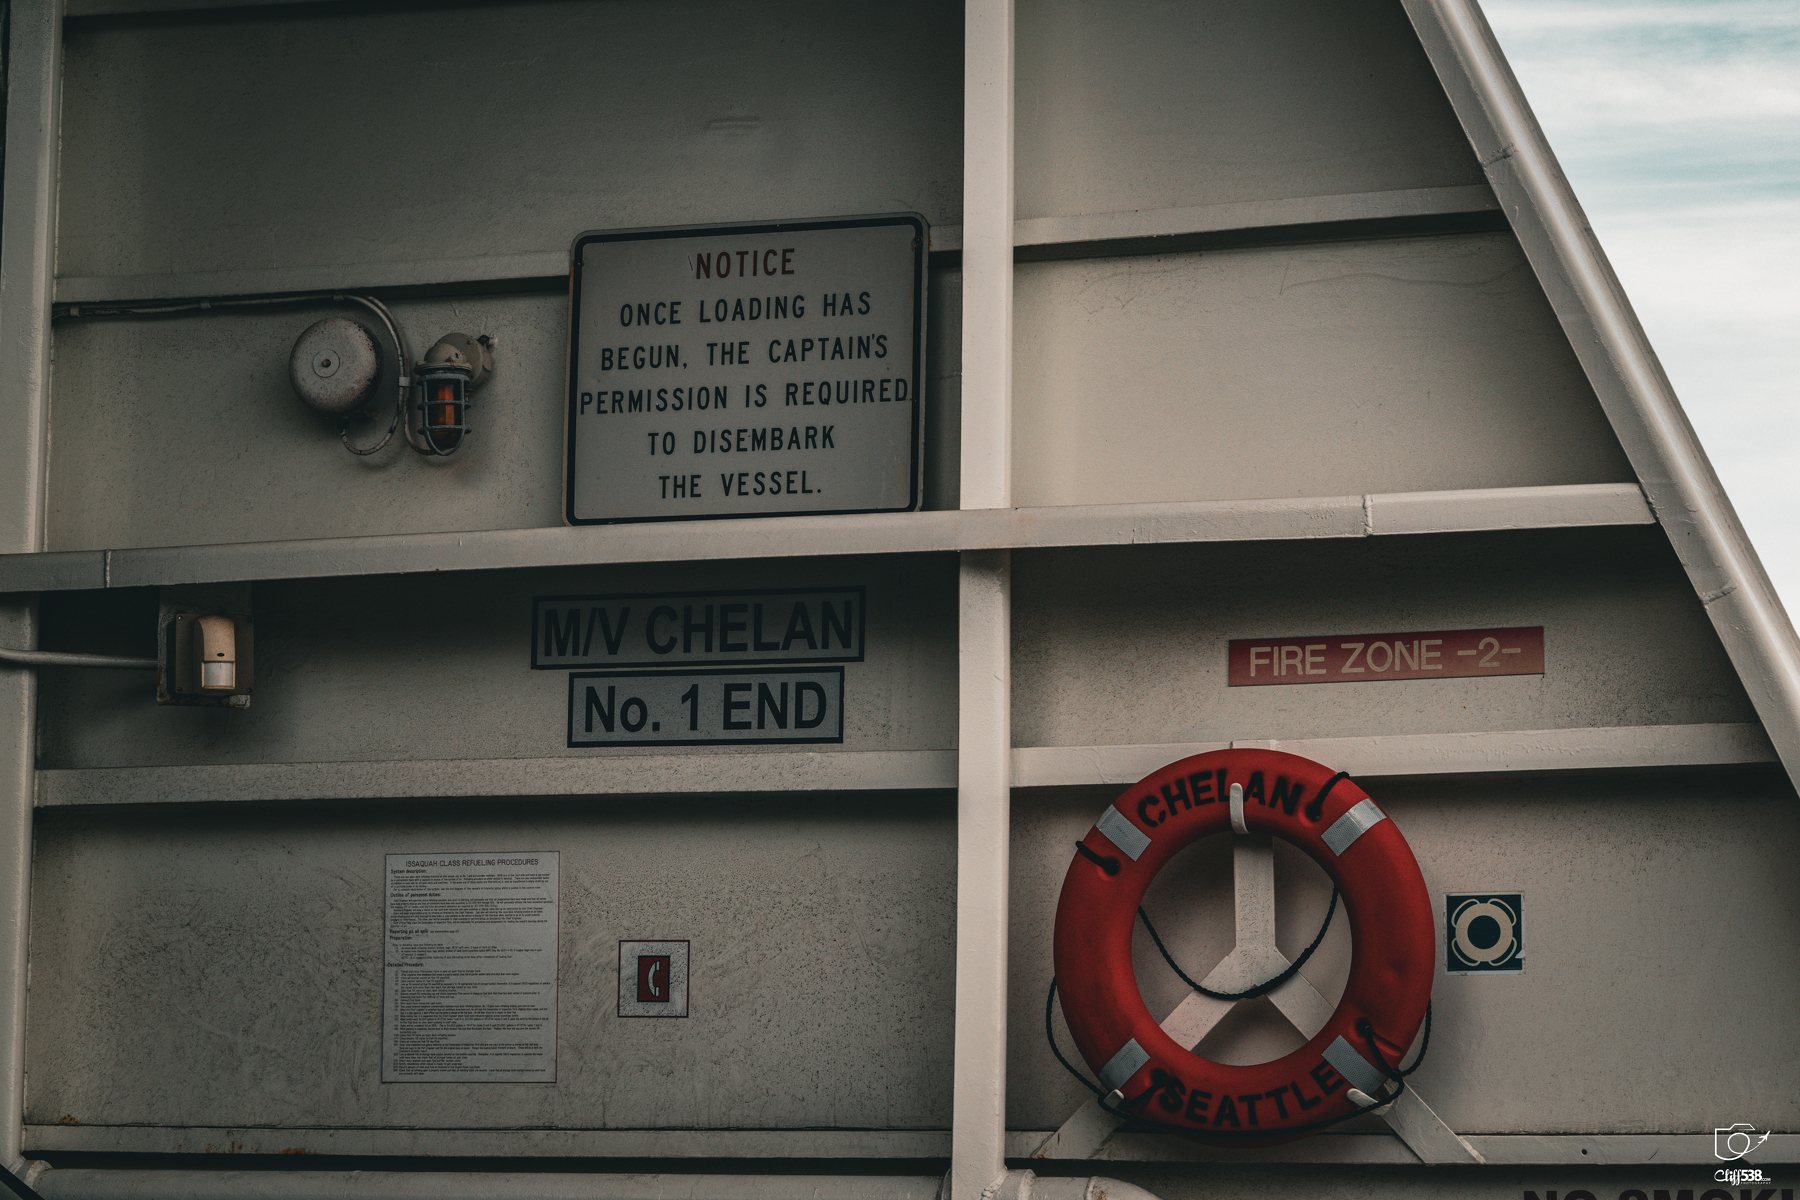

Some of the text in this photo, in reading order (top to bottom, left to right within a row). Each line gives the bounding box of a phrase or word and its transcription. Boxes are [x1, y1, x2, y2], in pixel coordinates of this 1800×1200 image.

[696, 248, 795, 280] NOTICE
[620, 292, 871, 327] ONCE LOADING HAS
[601, 334, 888, 371] BEGUN, THE CAPTAIN'S
[580, 378, 908, 415] PERMISSION IS REQUIRED
[648, 425, 835, 456] TO DISEMBARK
[659, 471, 822, 499] THE VESSEL.
[544, 600, 853, 657] M/V CHELAN
[1249, 644, 1327, 677] FIRE
[1341, 639, 1443, 674] ZONE
[584, 681, 827, 733] No. 1 END
[1136, 768, 1304, 828] CHELAN
[462, 859, 495, 867] REFUELING
[497, 858, 539, 866] PROCEDURES
[1161, 1060, 1345, 1128] SEATTLE
